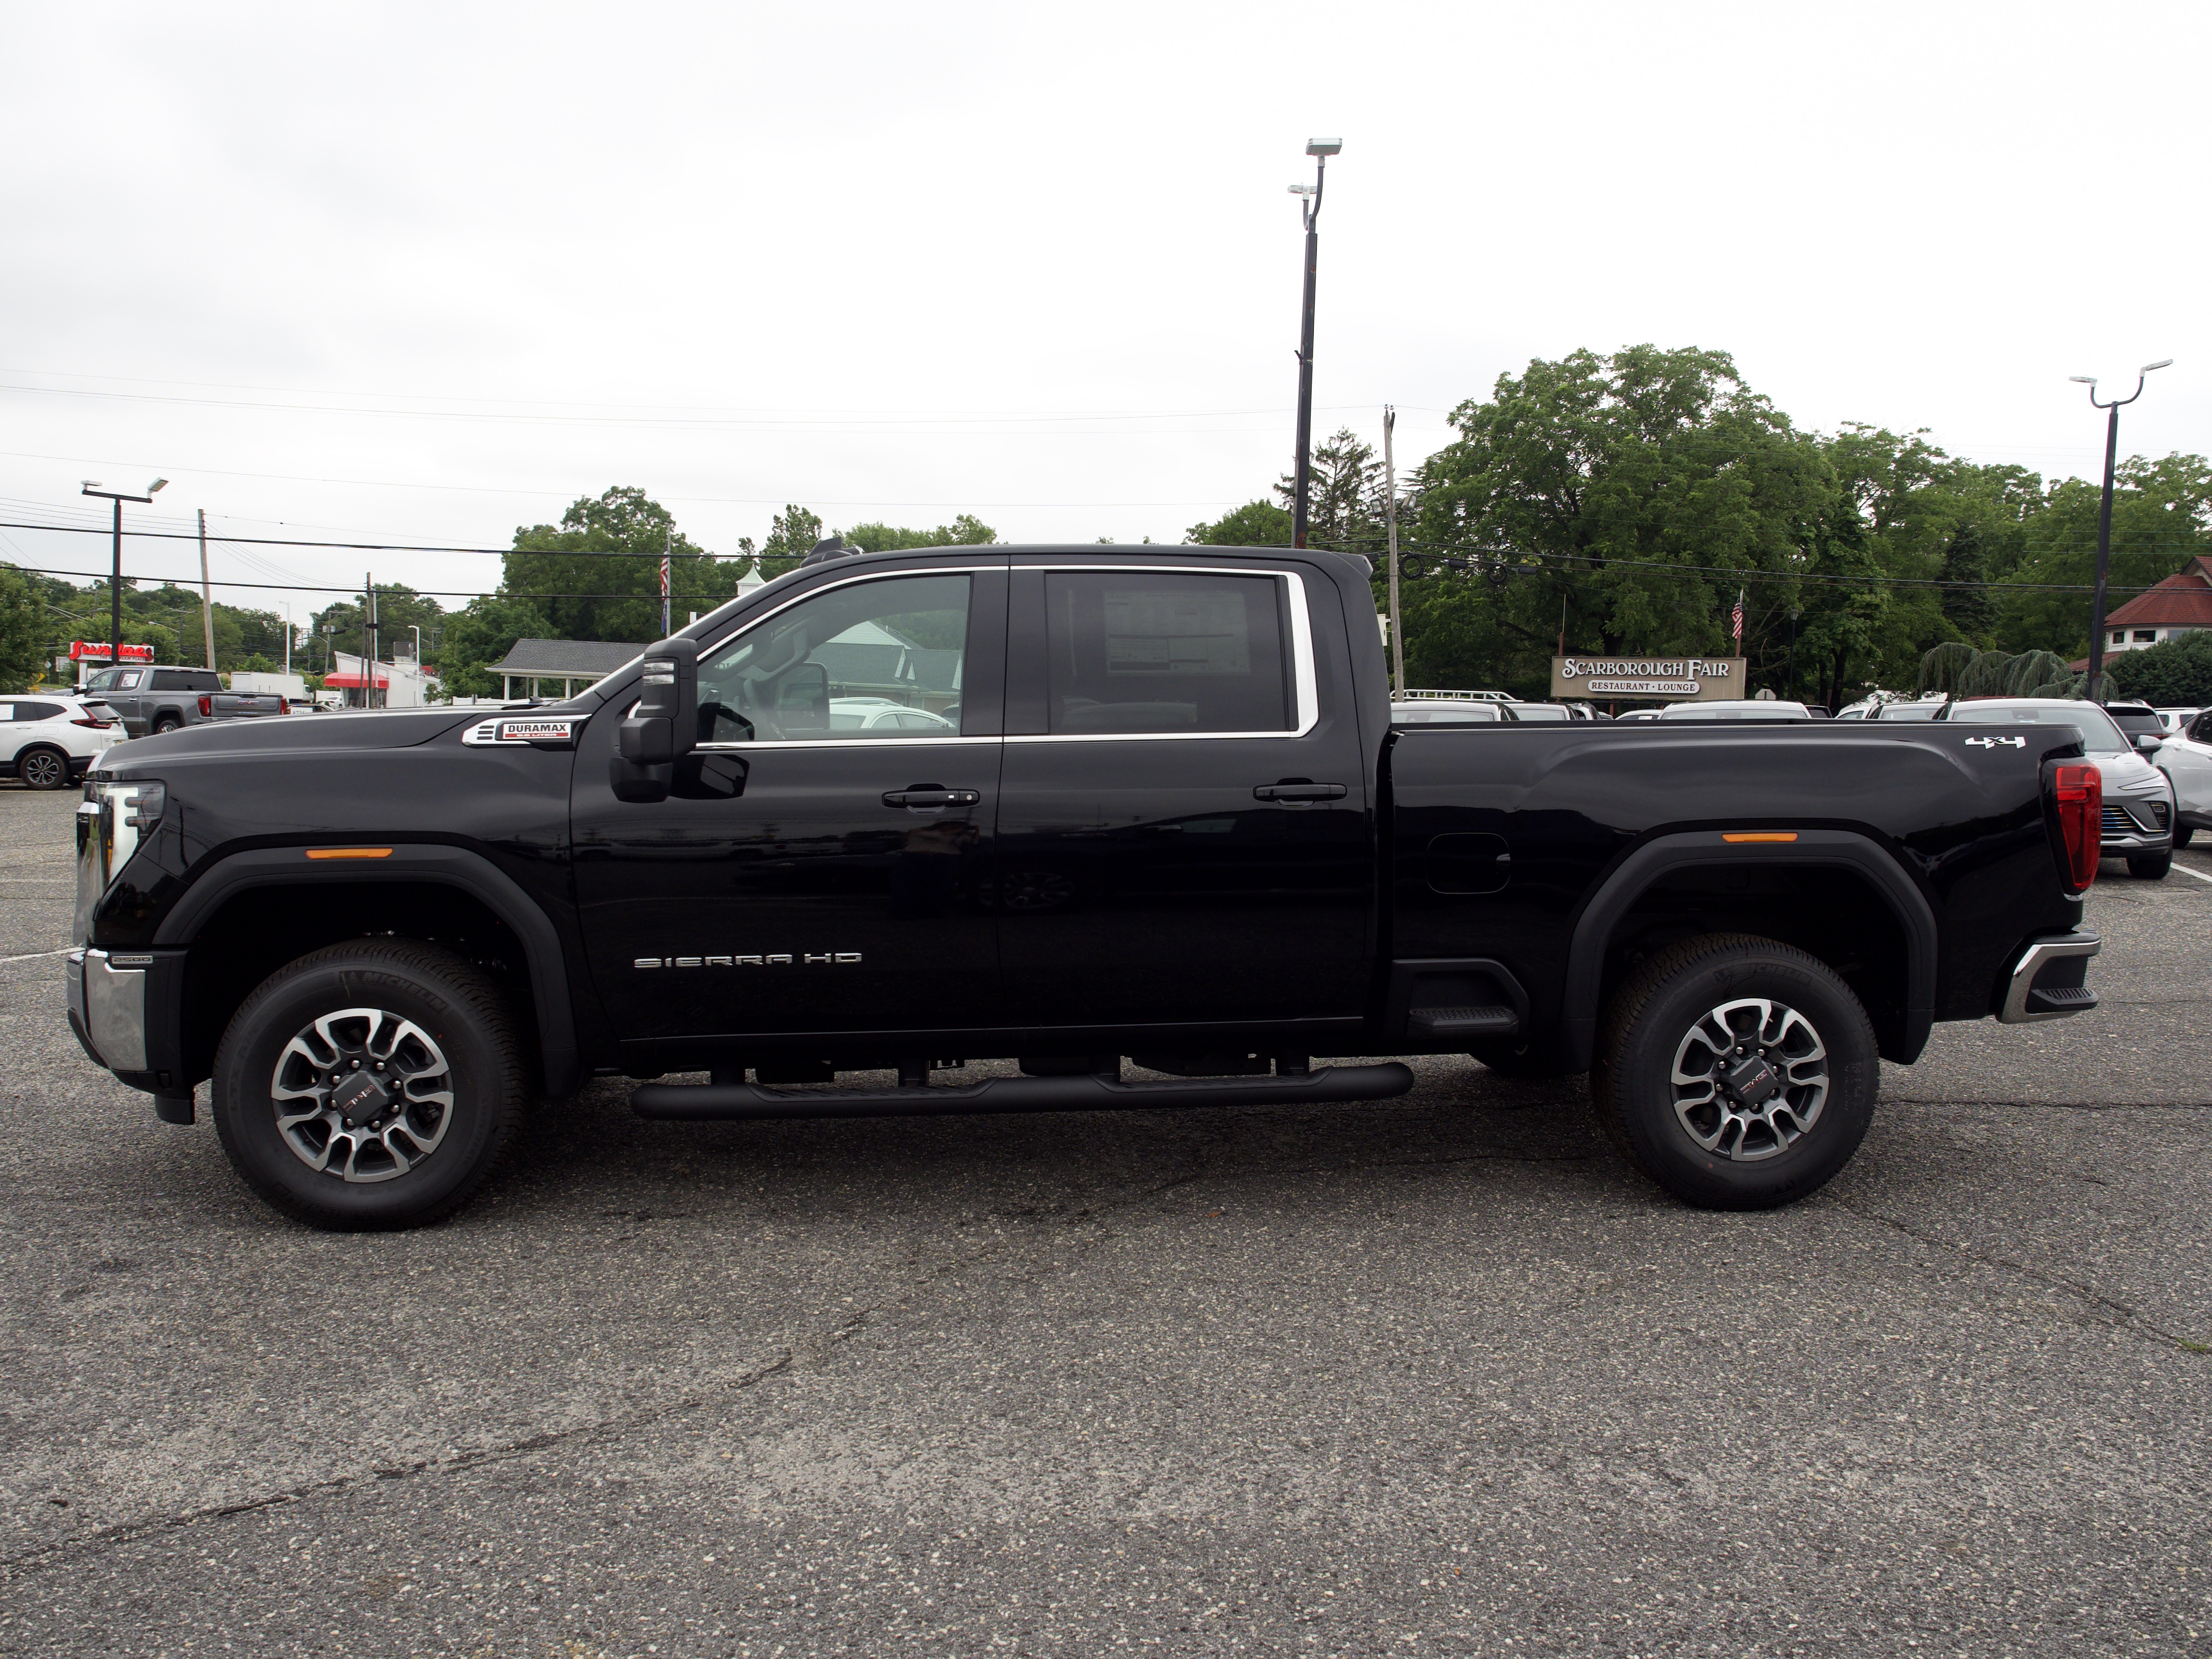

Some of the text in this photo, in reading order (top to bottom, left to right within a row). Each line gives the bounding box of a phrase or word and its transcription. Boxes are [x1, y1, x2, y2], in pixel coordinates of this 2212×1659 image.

[1561, 658, 1730, 681] SCARBOROUGH FAIR
[1591, 682, 1696, 691] RESTAURANT LOUNGE
[634, 952, 862, 969] SIERRA HD
[361, 971, 448, 1012] MICHELIN
[1740, 1069, 1769, 1095] GMC
[343, 1085, 375, 1112] GMC
